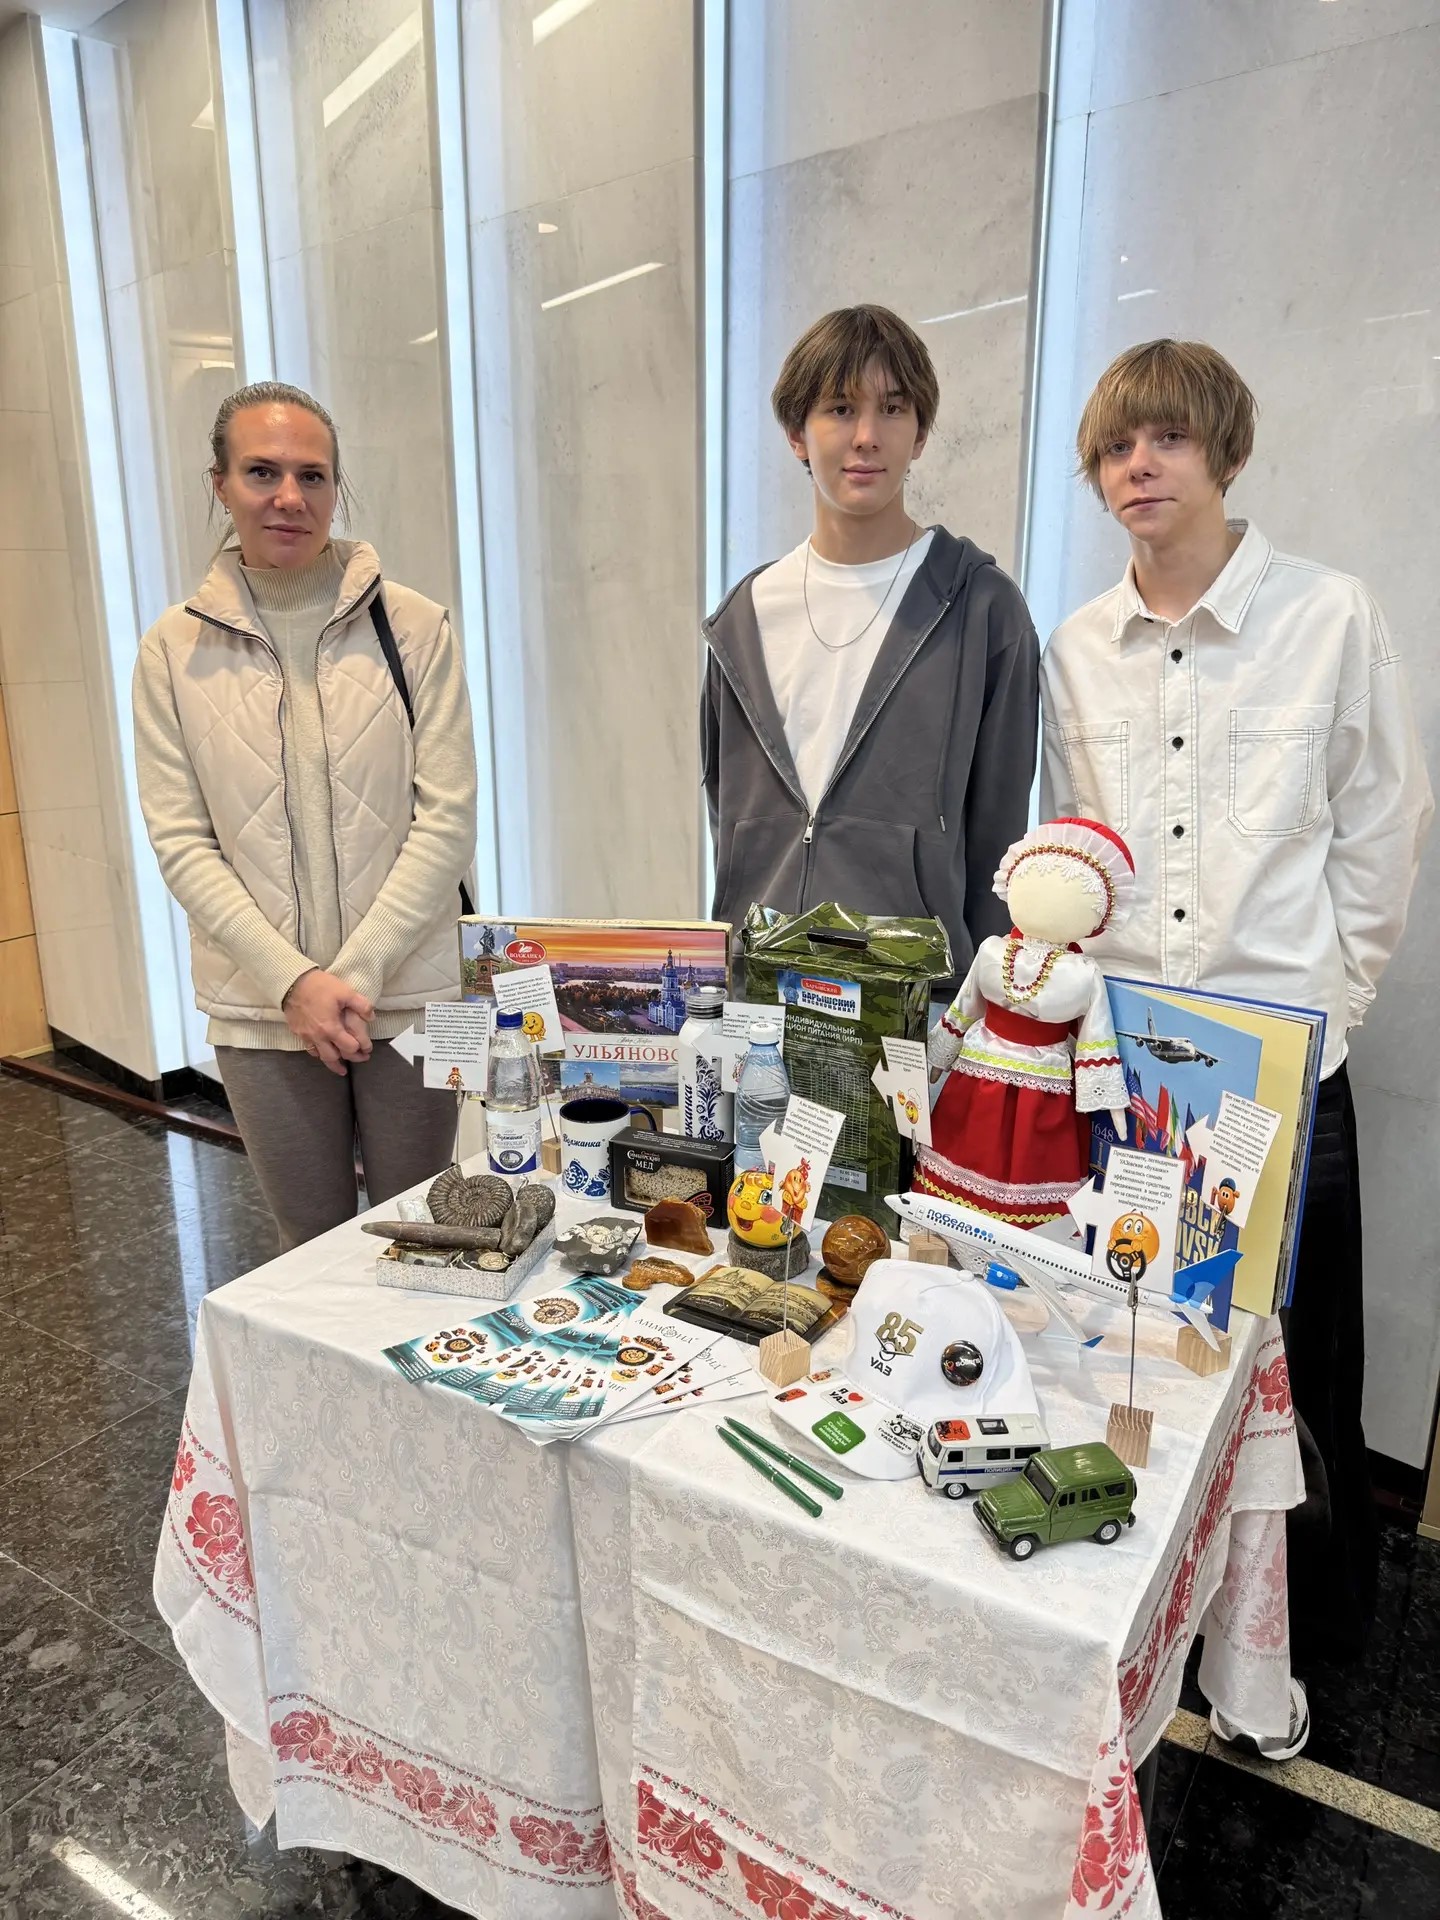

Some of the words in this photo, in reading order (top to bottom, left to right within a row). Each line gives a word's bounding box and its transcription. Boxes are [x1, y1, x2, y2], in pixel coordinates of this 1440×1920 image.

[802, 991, 856, 1008] БАРЫШСКИЙ
[802, 998, 856, 1013] МЯСОКОМБИНАТ
[785, 1014, 856, 1036] ИНДИВИДУАЛЬНЫЙ
[786, 1022, 806, 1032] ЦИОН
[808, 1026, 840, 1040] ПИТАНИЯ
[842, 1034, 863, 1046] (ИРП)
[573, 1044, 679, 1062] УЛЬЯНОВС
[684, 1084, 692, 1137] жанка
[562, 1134, 601, 1148] Волжанка
[927, 1208, 972, 1232] победа
[876, 1311, 924, 1354] 85
[870, 1356, 892, 1376] УАЗ
[828, 1390, 848, 1406] УАЗ
